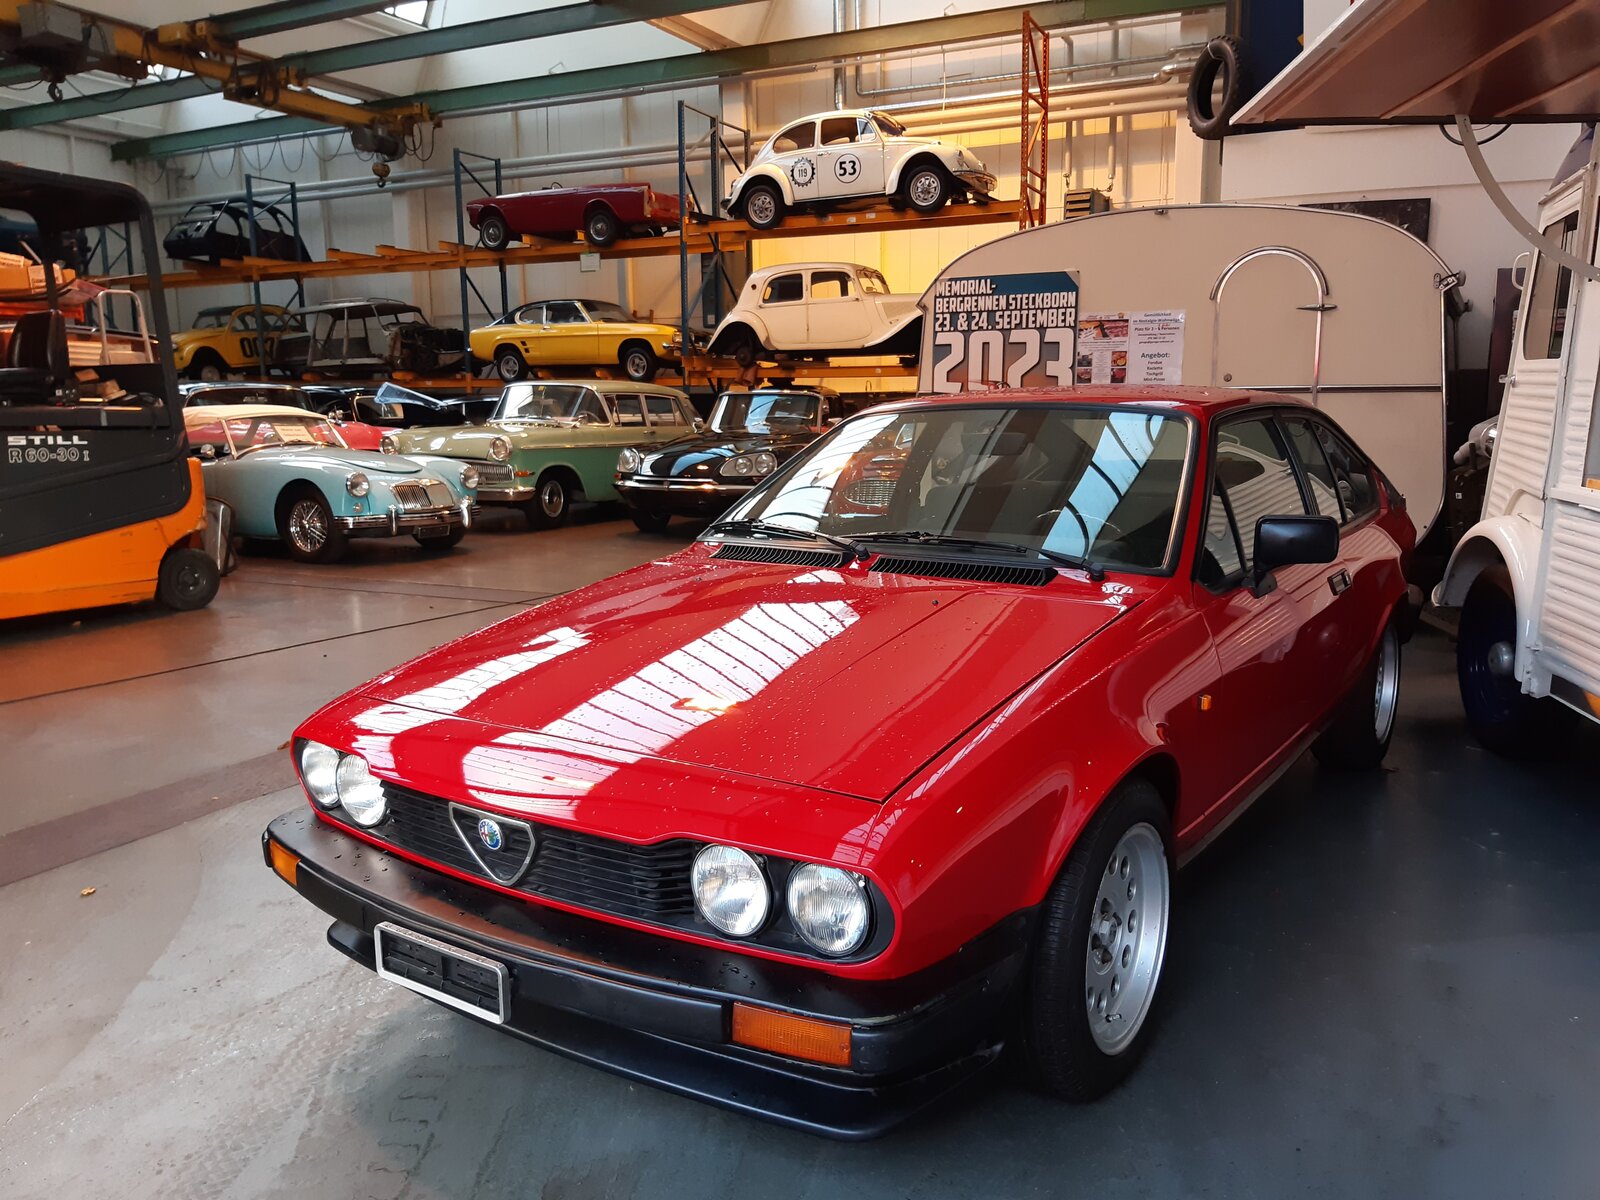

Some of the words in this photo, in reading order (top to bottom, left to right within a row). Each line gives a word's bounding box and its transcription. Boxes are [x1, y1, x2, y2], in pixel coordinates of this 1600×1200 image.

[798, 168, 808, 178] 119
[839, 160, 857, 177] 53
[936, 279, 997, 297] MEMORIAL-
[935, 294, 1007, 313] BERGRENNEN
[1009, 291, 1076, 310] STECKBORN
[935, 313, 955, 332] 23.
[957, 313, 969, 331] &
[971, 312, 992, 331] 24.
[995, 308, 1075, 329] SEPTEMBER
[933, 328, 1075, 393] 2023
[1141, 351, 1171, 359] Angebot:
[7, 435, 89, 446] STILL
[8, 448, 22, 463] R
[25, 447, 80, 463] 60-30
